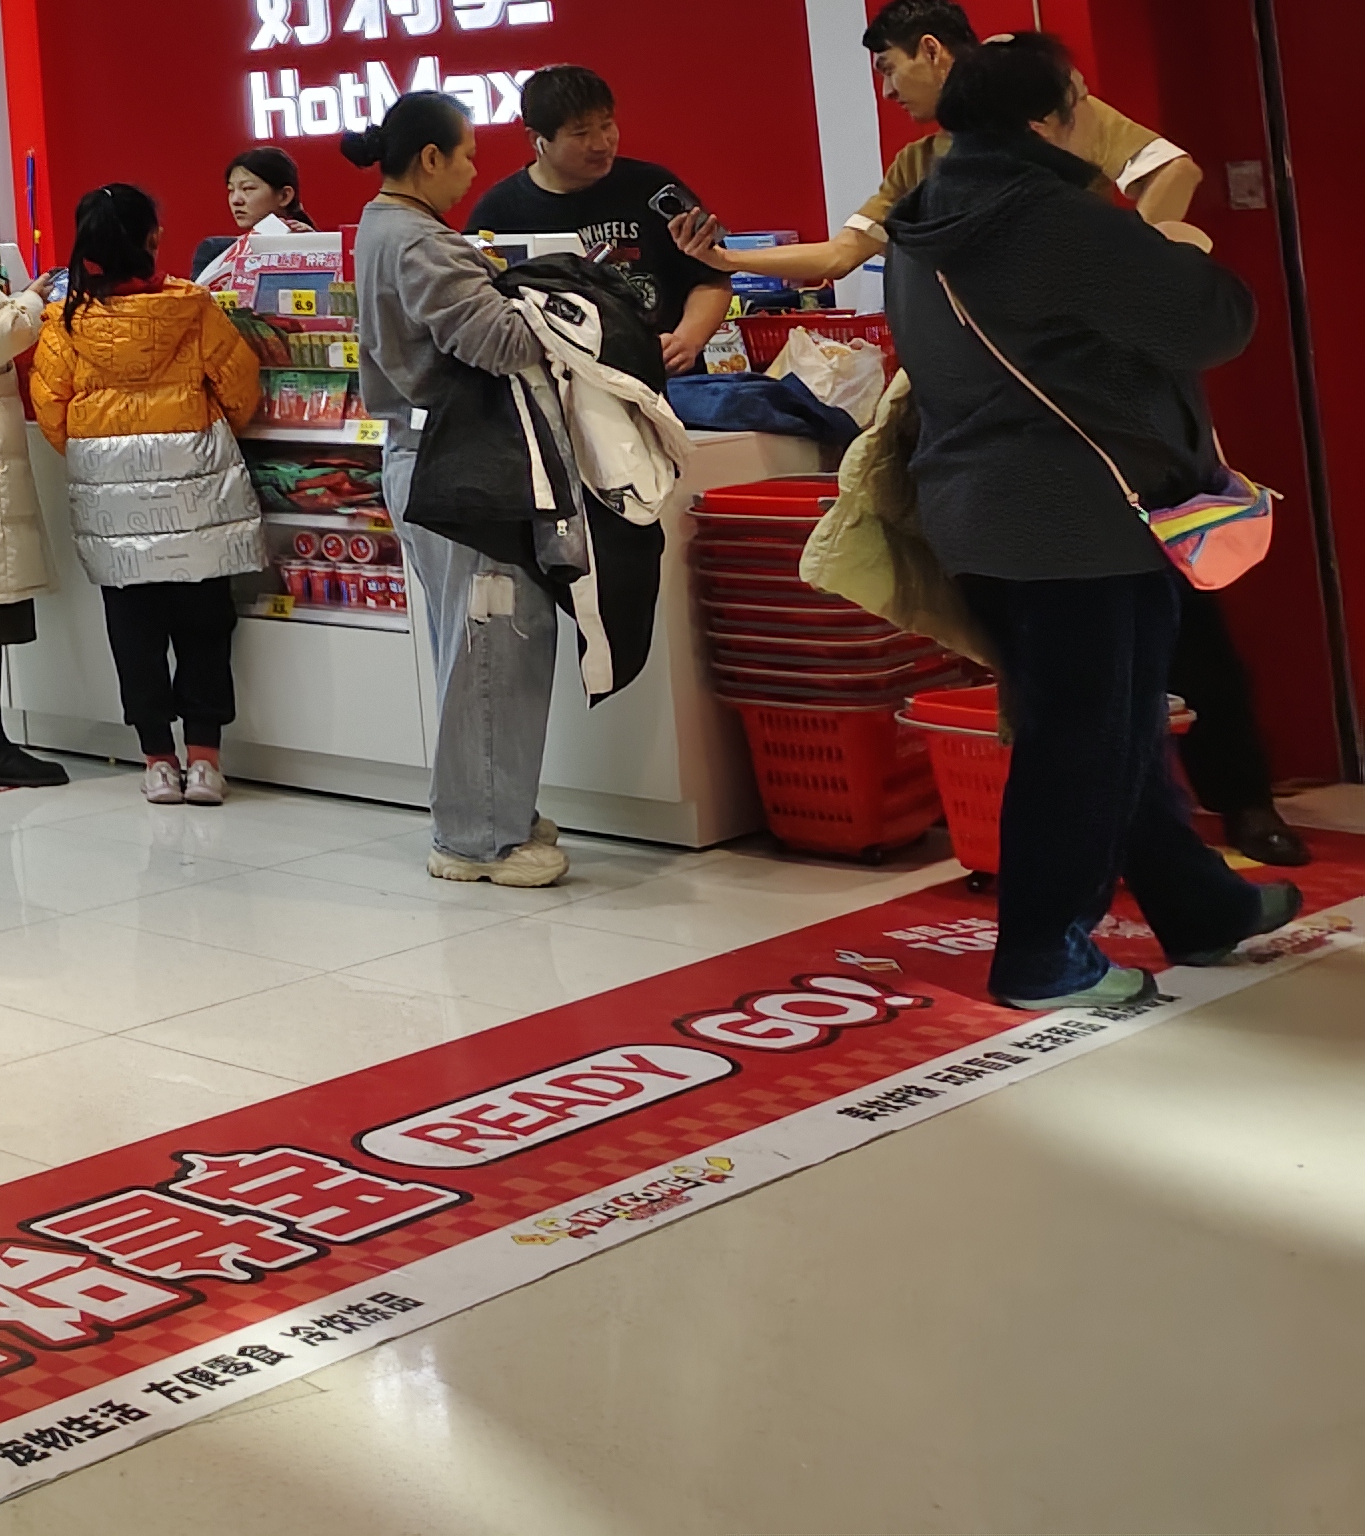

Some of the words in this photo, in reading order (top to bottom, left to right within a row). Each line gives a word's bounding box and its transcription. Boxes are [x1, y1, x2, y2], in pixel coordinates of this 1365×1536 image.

[577, 221, 640, 244] WHEELS
[400, 1052, 692, 1155] READY
[687, 974, 919, 1051] GO!
[573, 1175, 706, 1226] WELCOME
[141, 1343, 294, 1406] 方便零食
[279, 1290, 425, 1347] 冷饮冻品
